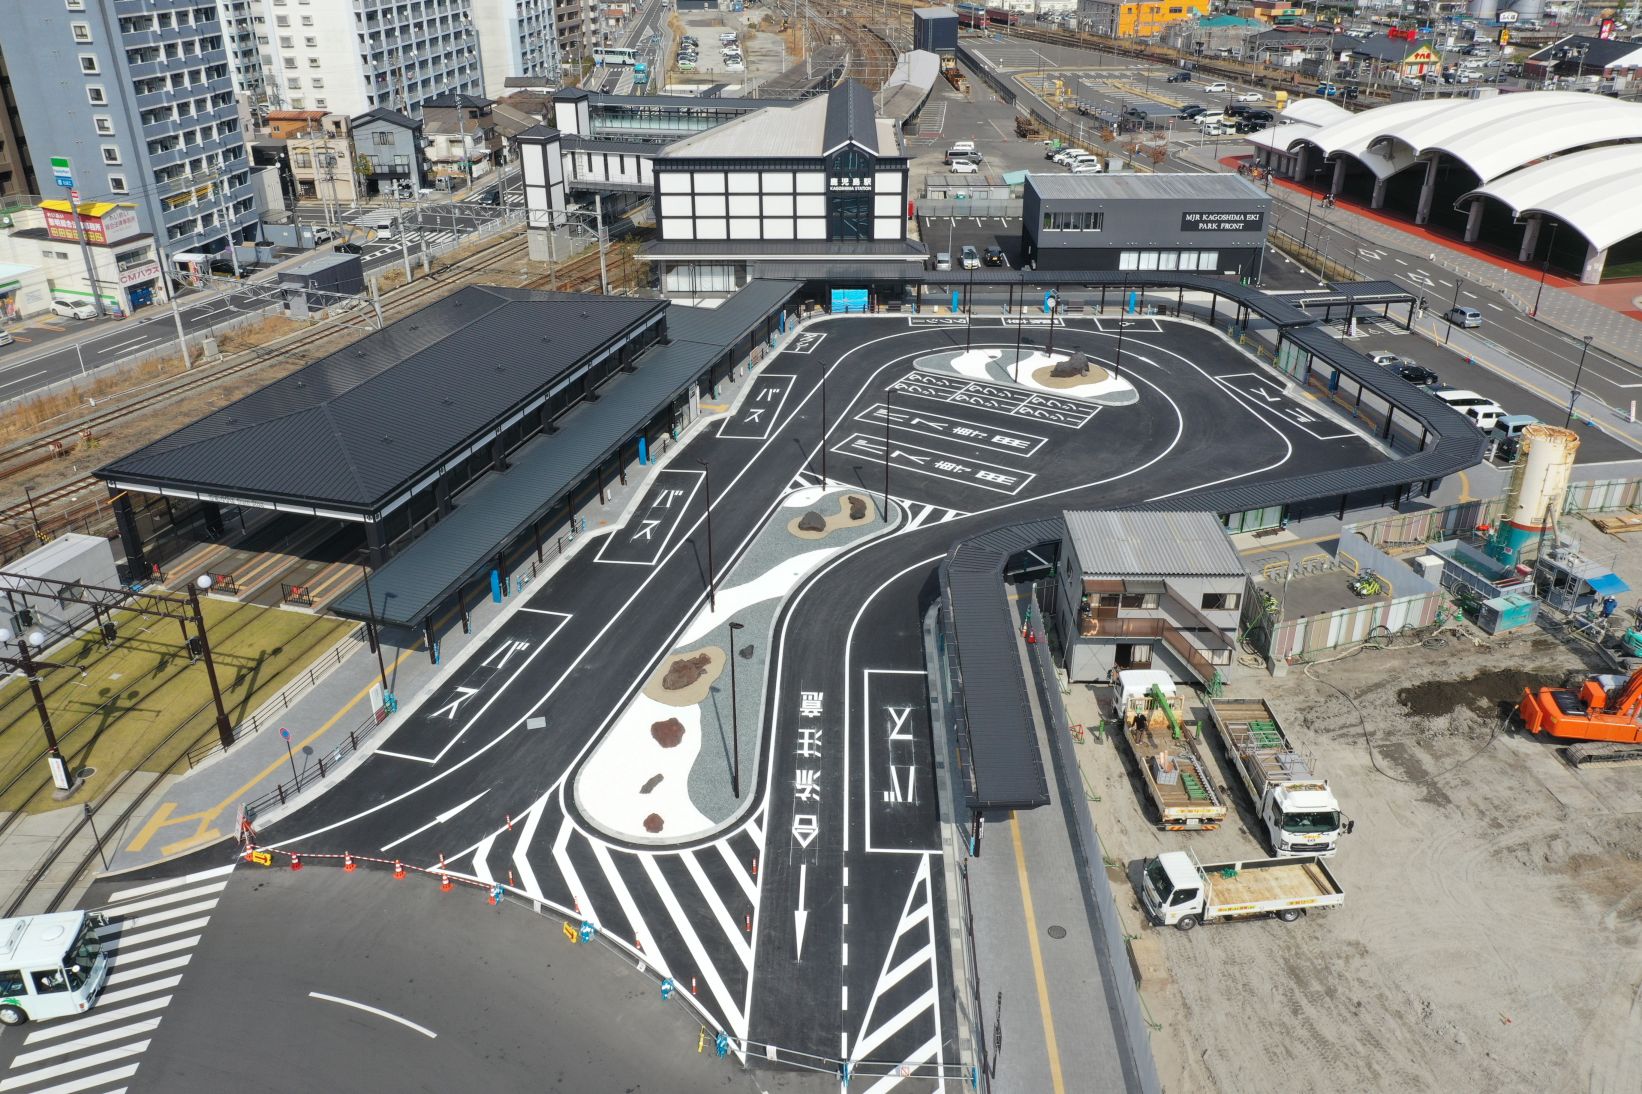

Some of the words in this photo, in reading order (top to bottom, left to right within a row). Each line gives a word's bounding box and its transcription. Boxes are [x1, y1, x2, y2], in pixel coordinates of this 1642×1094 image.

[909, 373, 966, 388] タクシー
[969, 384, 1028, 400] タクシー
[744, 388, 780, 422] バス
[955, 394, 1015, 410] タクシー
[1019, 407, 1083, 423] タクシー
[1033, 397, 1094, 412] タクシー
[1249, 388, 1316, 422] バス
[873, 408, 1031, 449] バス専用
[851, 439, 1018, 487] バス専用
[633, 490, 684, 540] バス
[428, 640, 530, 719] バス
[792, 691, 824, 848] 合流注意
[883, 706, 916, 802] バス
